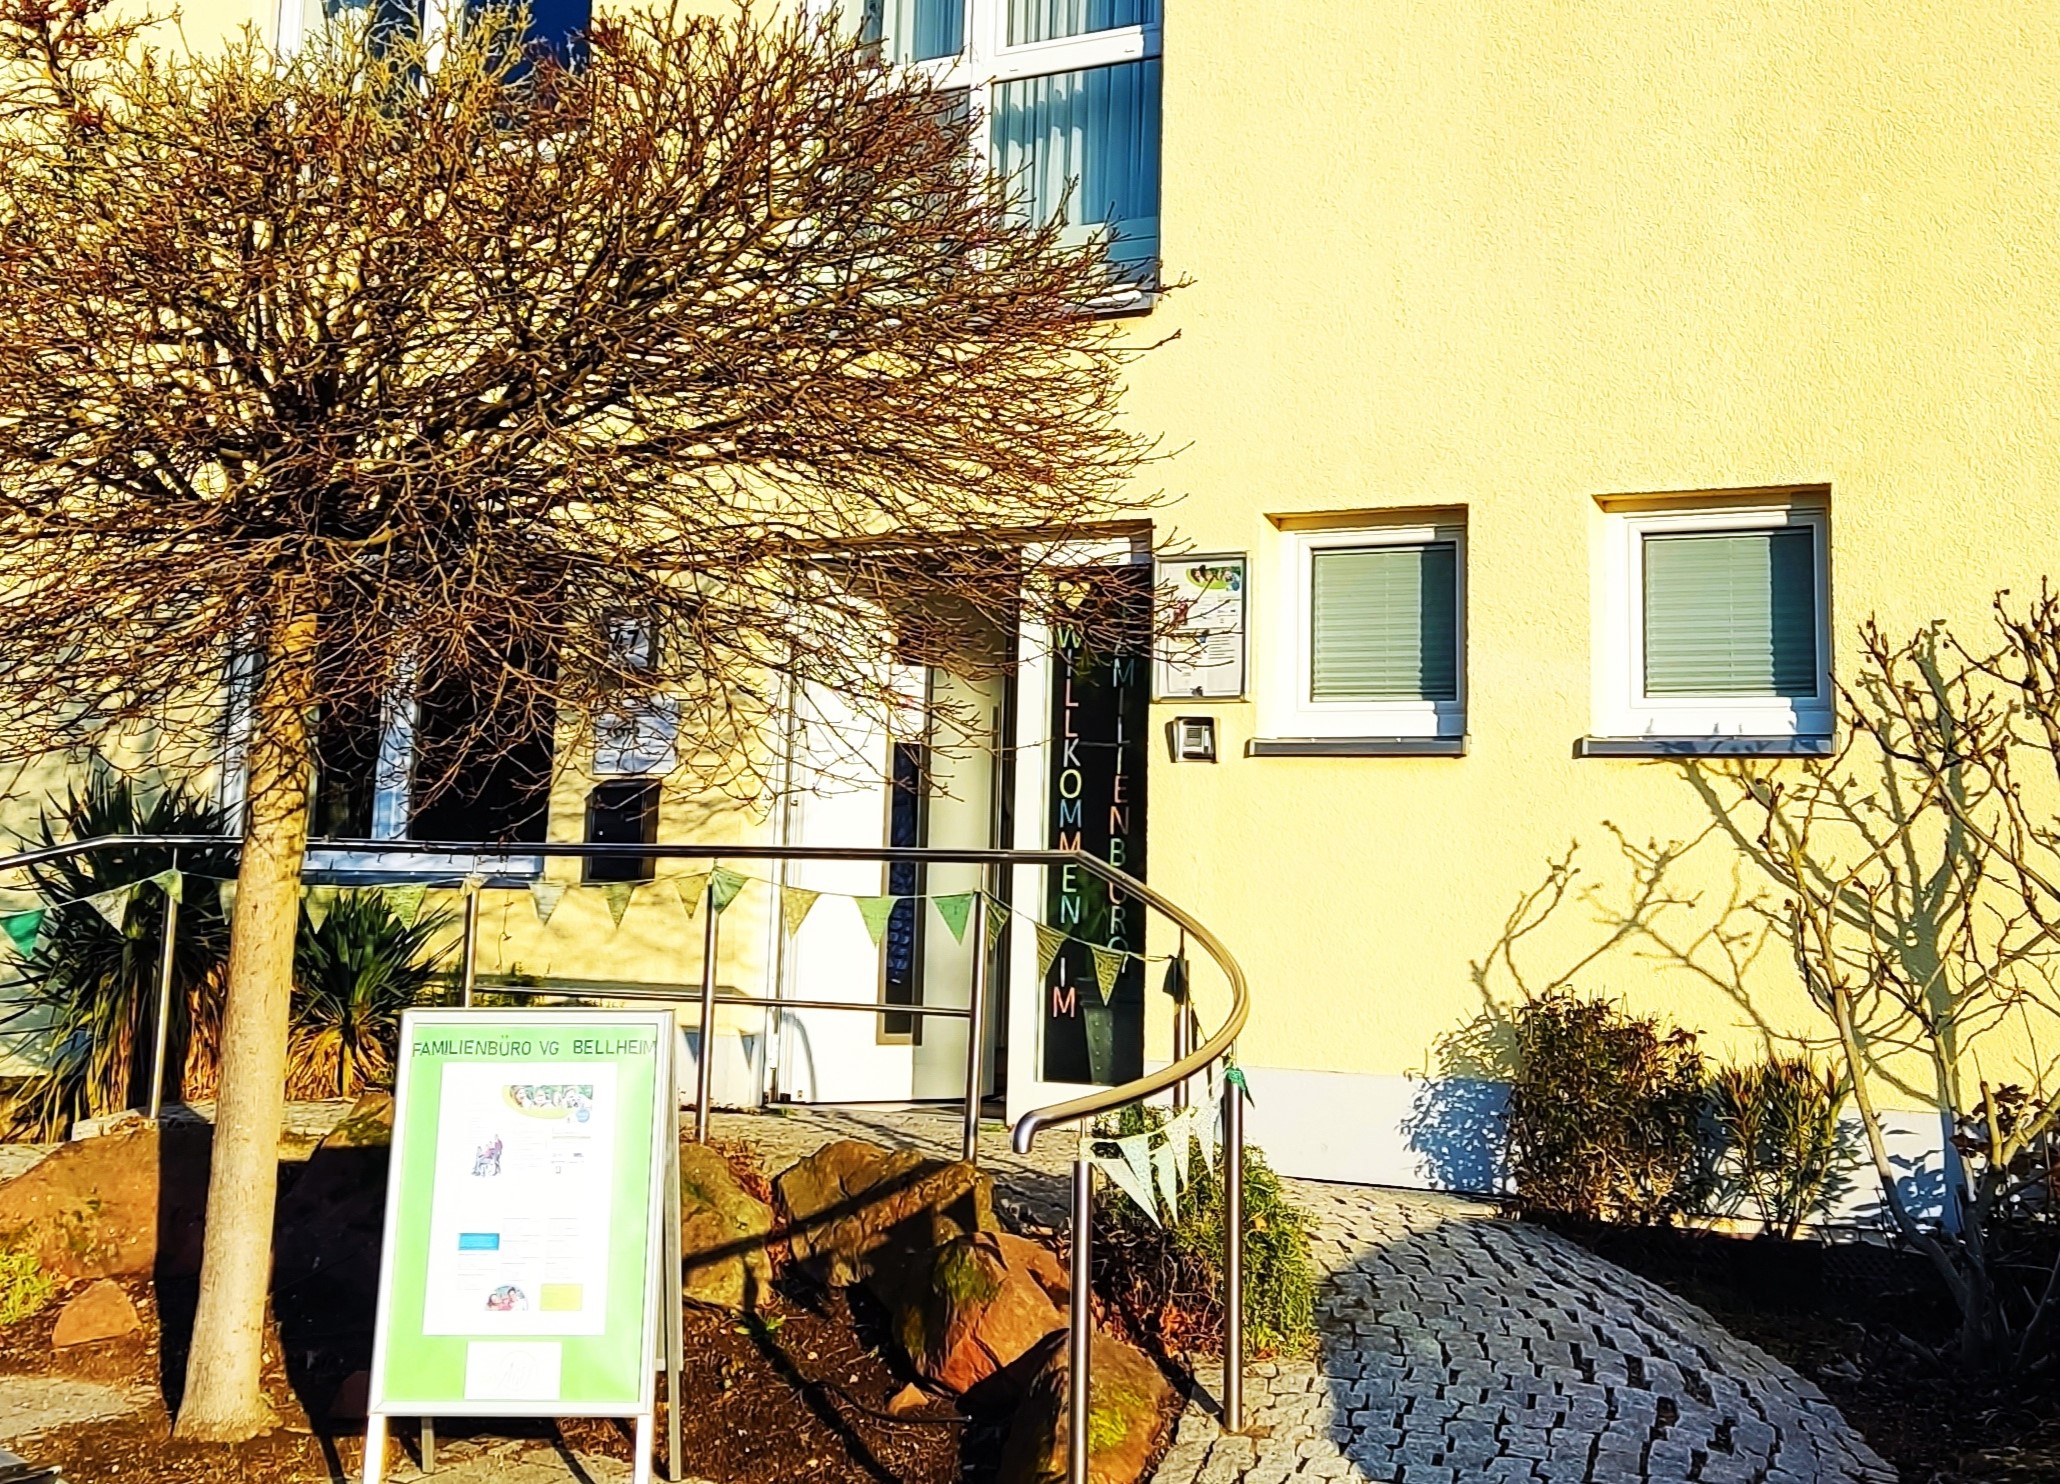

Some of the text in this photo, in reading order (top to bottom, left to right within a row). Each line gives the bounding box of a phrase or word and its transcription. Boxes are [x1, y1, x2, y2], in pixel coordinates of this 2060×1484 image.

[1053, 624, 1083, 1018] WILLKOMMEN IM
[1107, 600, 1136, 964] MILIENBRO
[411, 1034, 657, 1057] FAMILIENBÜRO VG BELLHEIM
